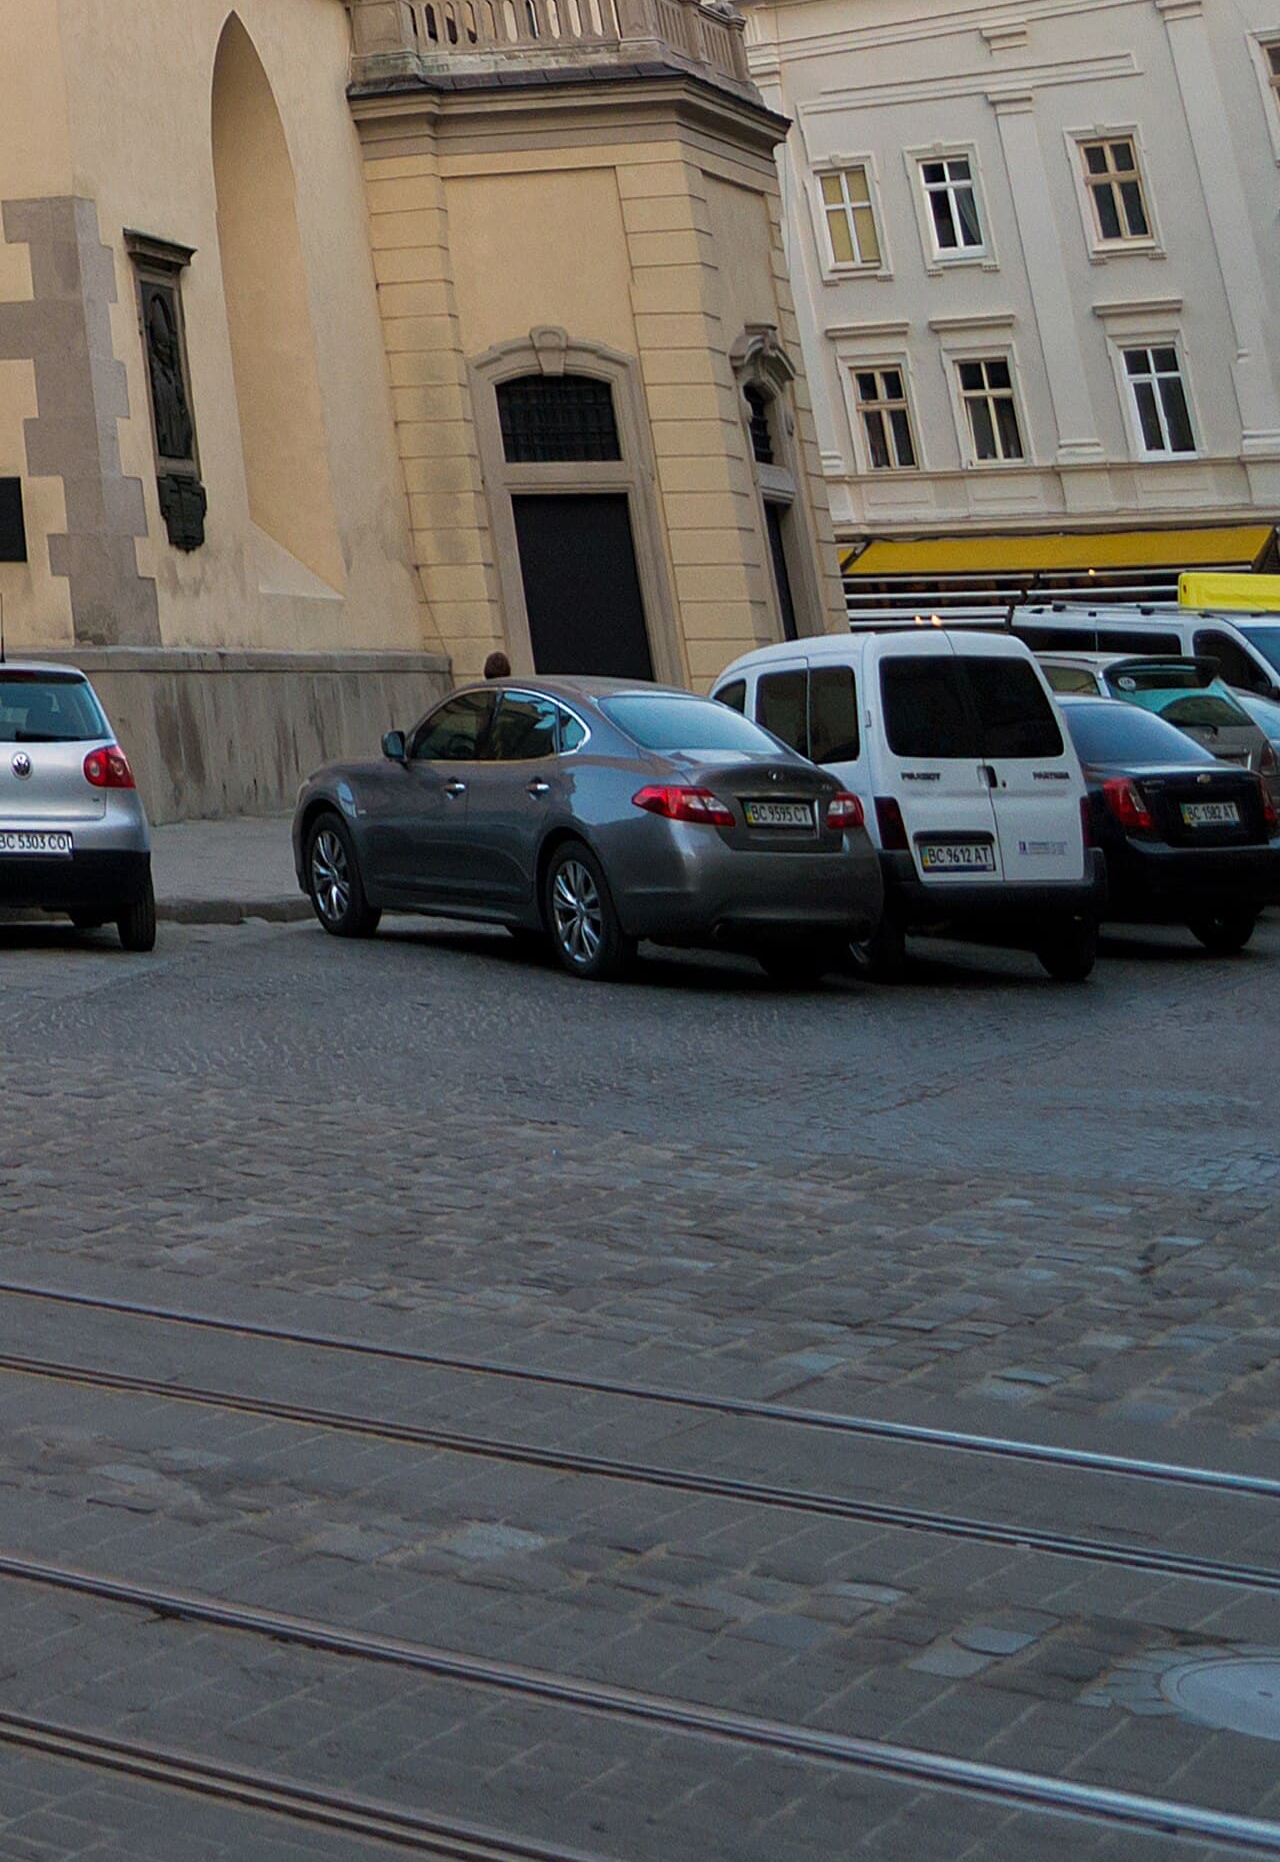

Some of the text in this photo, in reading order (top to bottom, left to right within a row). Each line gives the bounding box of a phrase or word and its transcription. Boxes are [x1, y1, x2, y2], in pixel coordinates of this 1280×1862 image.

[751, 804, 767, 821] BC
[1189, 806, 1203, 822] BC
[1223, 804, 1236, 818] AT
[18, 834, 45, 850] 5303
[48, 835, 66, 850] CO
[928, 847, 989, 863] BC 9612 AT
